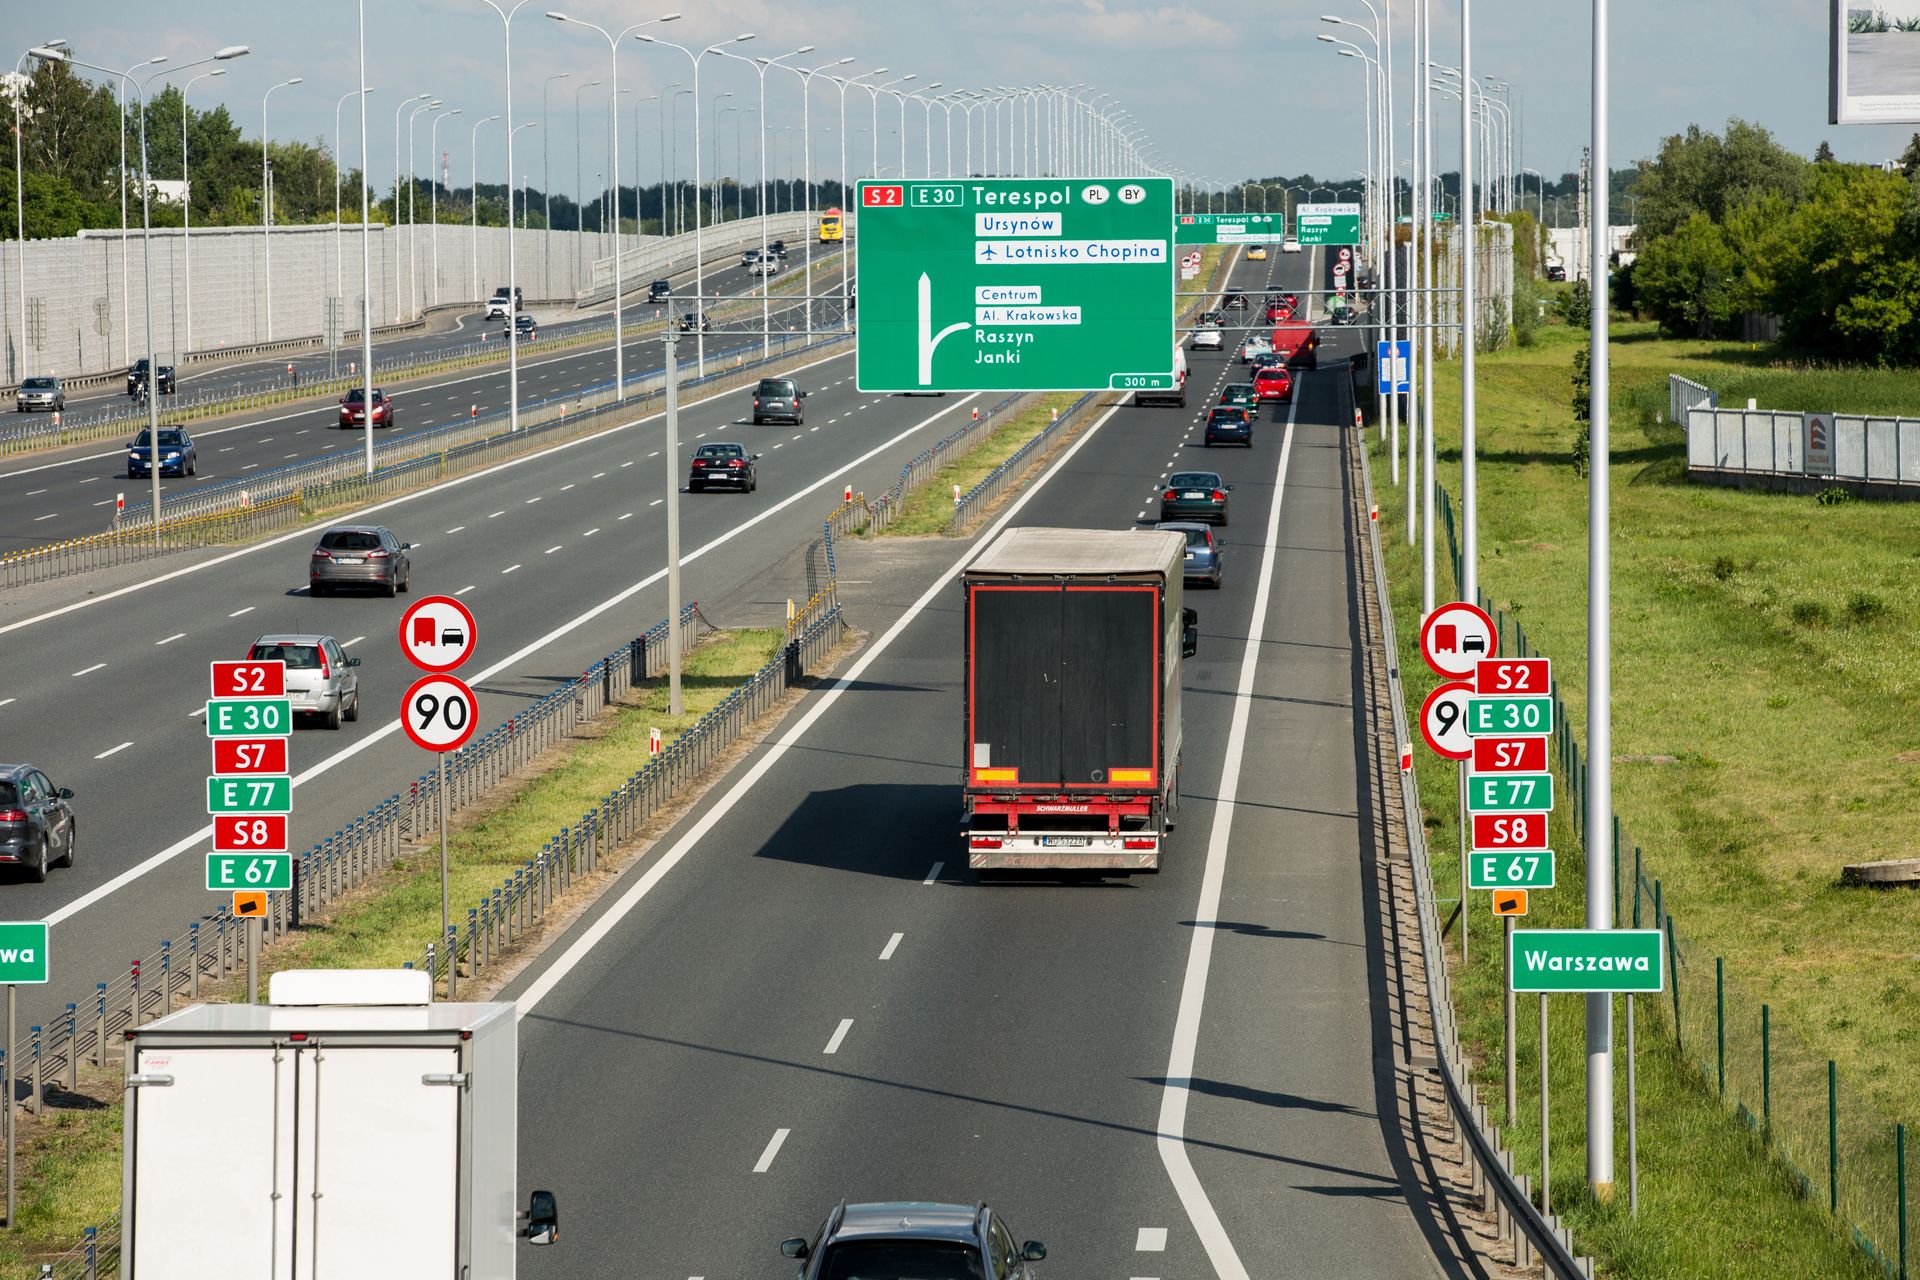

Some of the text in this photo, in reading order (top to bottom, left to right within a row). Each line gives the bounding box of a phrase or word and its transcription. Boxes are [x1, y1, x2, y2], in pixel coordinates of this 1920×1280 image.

[920, 189, 955, 203] E 30
[972, 186, 1070, 209] Terespol
[1089, 189, 1103, 201] PL
[1125, 189, 1139, 200] BY
[984, 216, 1053, 234] Ursynów
[1301, 226, 1328, 234] Raszyn
[1006, 244, 1160, 262] Lotnisko Chopina
[982, 289, 1038, 301] Centrum
[983, 310, 1077, 320] Al. Krakowska
[976, 330, 1034, 347] Raszyn
[975, 350, 1020, 364] Janki
[1124, 377, 1160, 387] 300 m
[233, 668, 265, 691] S2
[1496, 665, 1529, 689] S2
[219, 705, 279, 730] E 30
[416, 694, 467, 731] 90
[1436, 701, 1473, 738] 9
[1479, 703, 1540, 728] E 30
[235, 744, 265, 768] S7
[1495, 743, 1525, 767] S7
[224, 782, 274, 806] E 77
[1484, 781, 1536, 805] E 77
[233, 820, 268, 845] S8
[1493, 818, 1528, 843] S8
[221, 859, 278, 883] E 67
[1483, 857, 1540, 882] E 67
[1525, 951, 1649, 971] Warszawa
